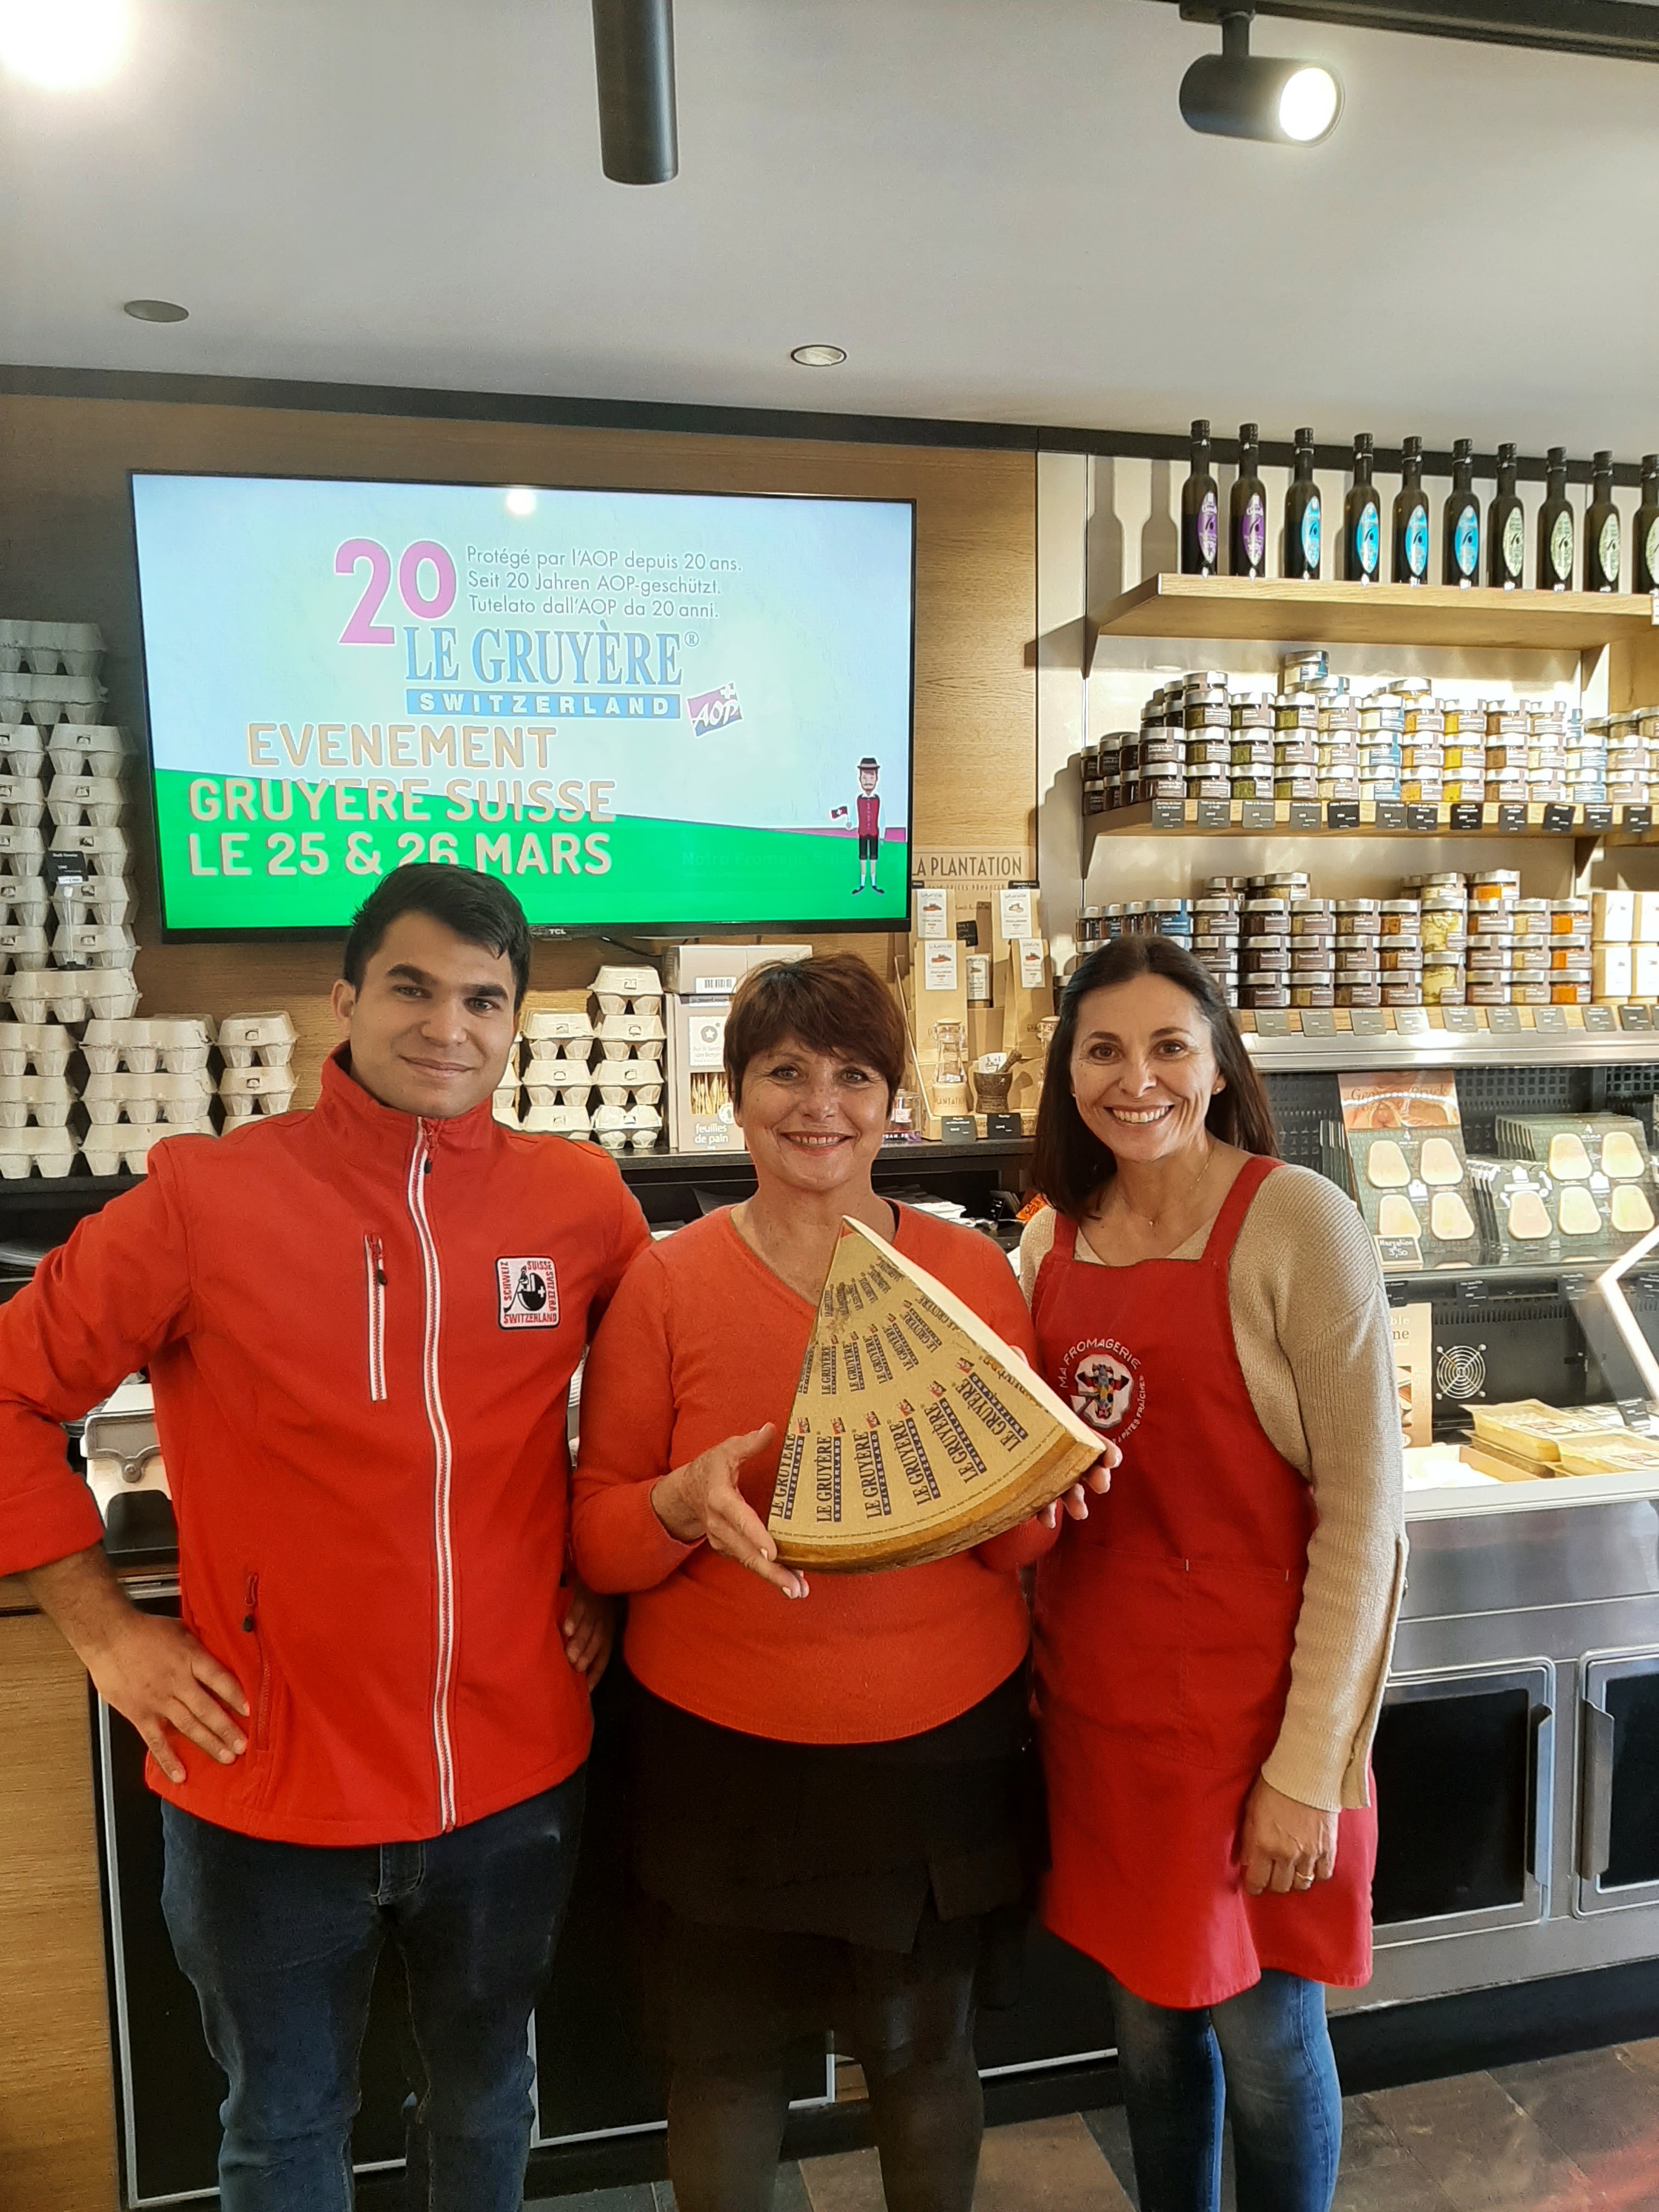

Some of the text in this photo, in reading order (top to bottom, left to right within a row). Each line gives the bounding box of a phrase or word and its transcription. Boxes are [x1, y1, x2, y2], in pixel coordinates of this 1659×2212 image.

[467, 546, 742, 573] Protégé par l'AOP depuis 20 ans.
[334, 538, 456, 645] 20
[468, 571, 721, 597] Seit 20 Jahren AOP-geschützt.
[469, 594, 719, 618] Tutelato dall'AOP da 20 anni.
[403, 625, 460, 681] LE
[419, 692, 670, 716] SWITZERLAND
[691, 699, 739, 727] AOP
[247, 722, 557, 769] EVENEMENT
[188, 778, 617, 823] GRUYERE SUISSE
[188, 831, 612, 877] LE 25 & 26 MARS
[912, 856, 1022, 877] A PLANTATION
[695, 1122, 727, 1135] feuilles
[695, 1133, 729, 1145] de pain
[500, 1261, 512, 1301] SCHWEIZ
[546, 1271, 557, 1311] SVIZZERA
[503, 1313, 557, 1324] SWITZERLAND
[1058, 1338, 1142, 1389] MA FROMAGERIE
[955, 1378, 1007, 1436] GRUYÈRE
[889, 1420, 924, 1485] GRUYÈRE
[924, 1402, 968, 1464] GRUYÈRE
[941, 1401, 985, 1472] SWITZERLAND
[1000, 1432, 1023, 1452] LE
[785, 1438, 804, 1518] SWITZERLAND
[814, 1436, 832, 1522] LE GRUYÈRE
[854, 1431, 883, 1519] LE GRUYÈRE
[871, 1433, 890, 1513] SWITZERLAND
[907, 1420, 940, 1497] SWITZERLAND
[958, 1462, 979, 1483] LE
[912, 1485, 932, 1506] LE
